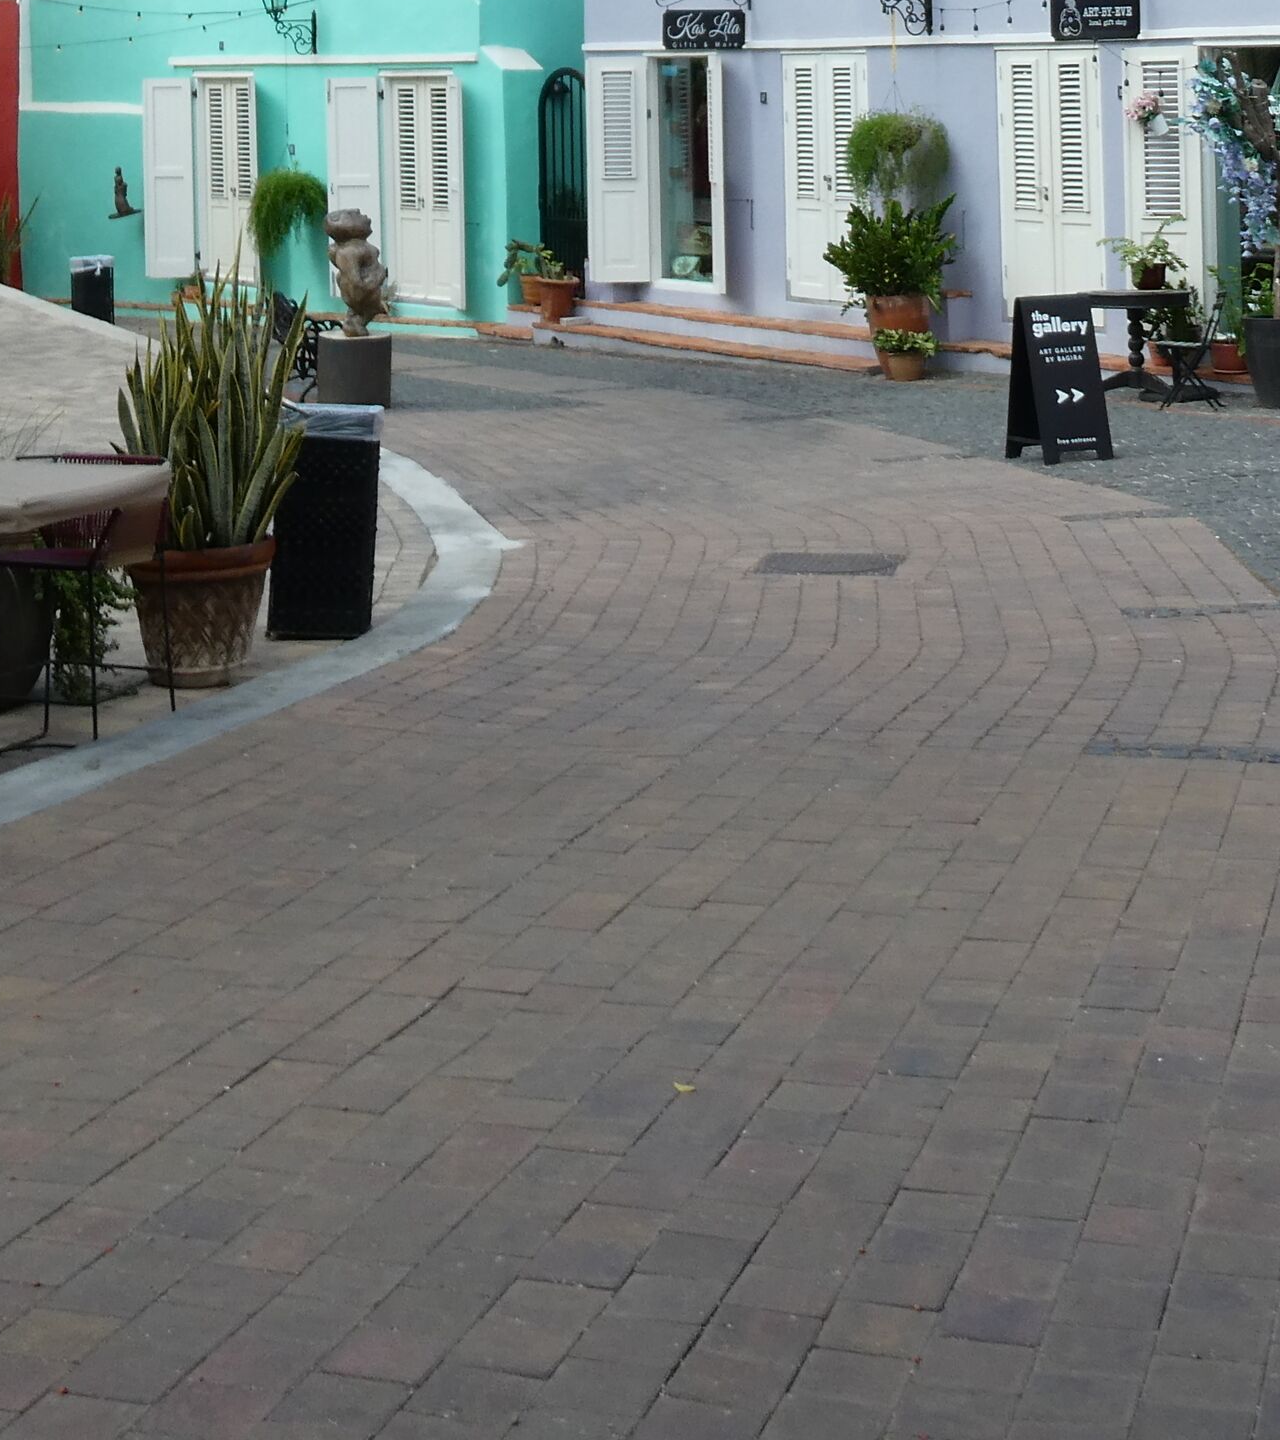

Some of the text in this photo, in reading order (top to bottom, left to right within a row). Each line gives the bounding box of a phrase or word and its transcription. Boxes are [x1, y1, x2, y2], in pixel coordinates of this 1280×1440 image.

[1082, 6, 1133, 17] ART-BY-EVE
[667, 11, 740, 42] Kas Lila
[1031, 310, 1049, 321] the
[1032, 316, 1088, 338] gallery
[1054, 345, 1086, 354] GALLERY
[1056, 354, 1083, 362] BAGIRA
